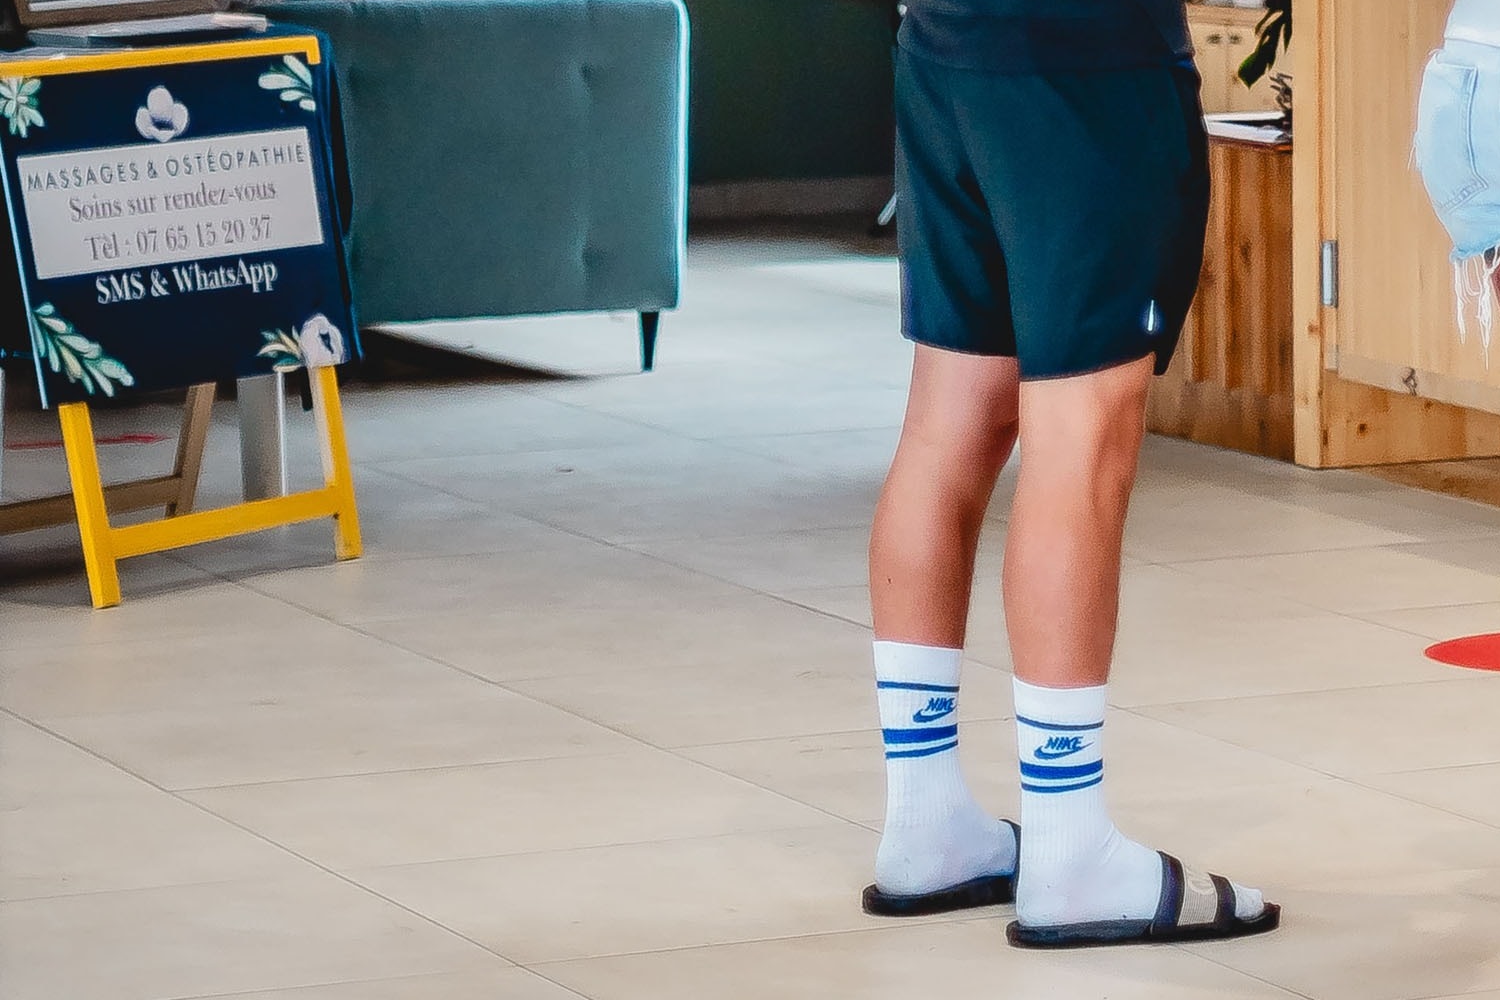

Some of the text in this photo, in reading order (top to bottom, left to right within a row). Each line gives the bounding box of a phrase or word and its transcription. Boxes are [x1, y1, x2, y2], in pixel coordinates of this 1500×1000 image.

[27, 144, 305, 191] MASSAGES & OSTÉOPATHIE
[69, 181, 276, 222] Soins sur rendez-vous
[136, 229, 158, 254] 07
[165, 224, 188, 251] 65
[196, 222, 216, 248] 15
[222, 218, 245, 244] 20
[251, 214, 272, 240] 37
[96, 258, 278, 304] SMS & WhatsApp
[924, 696, 955, 712] NIKE
[1044, 735, 1083, 751] NIKE
